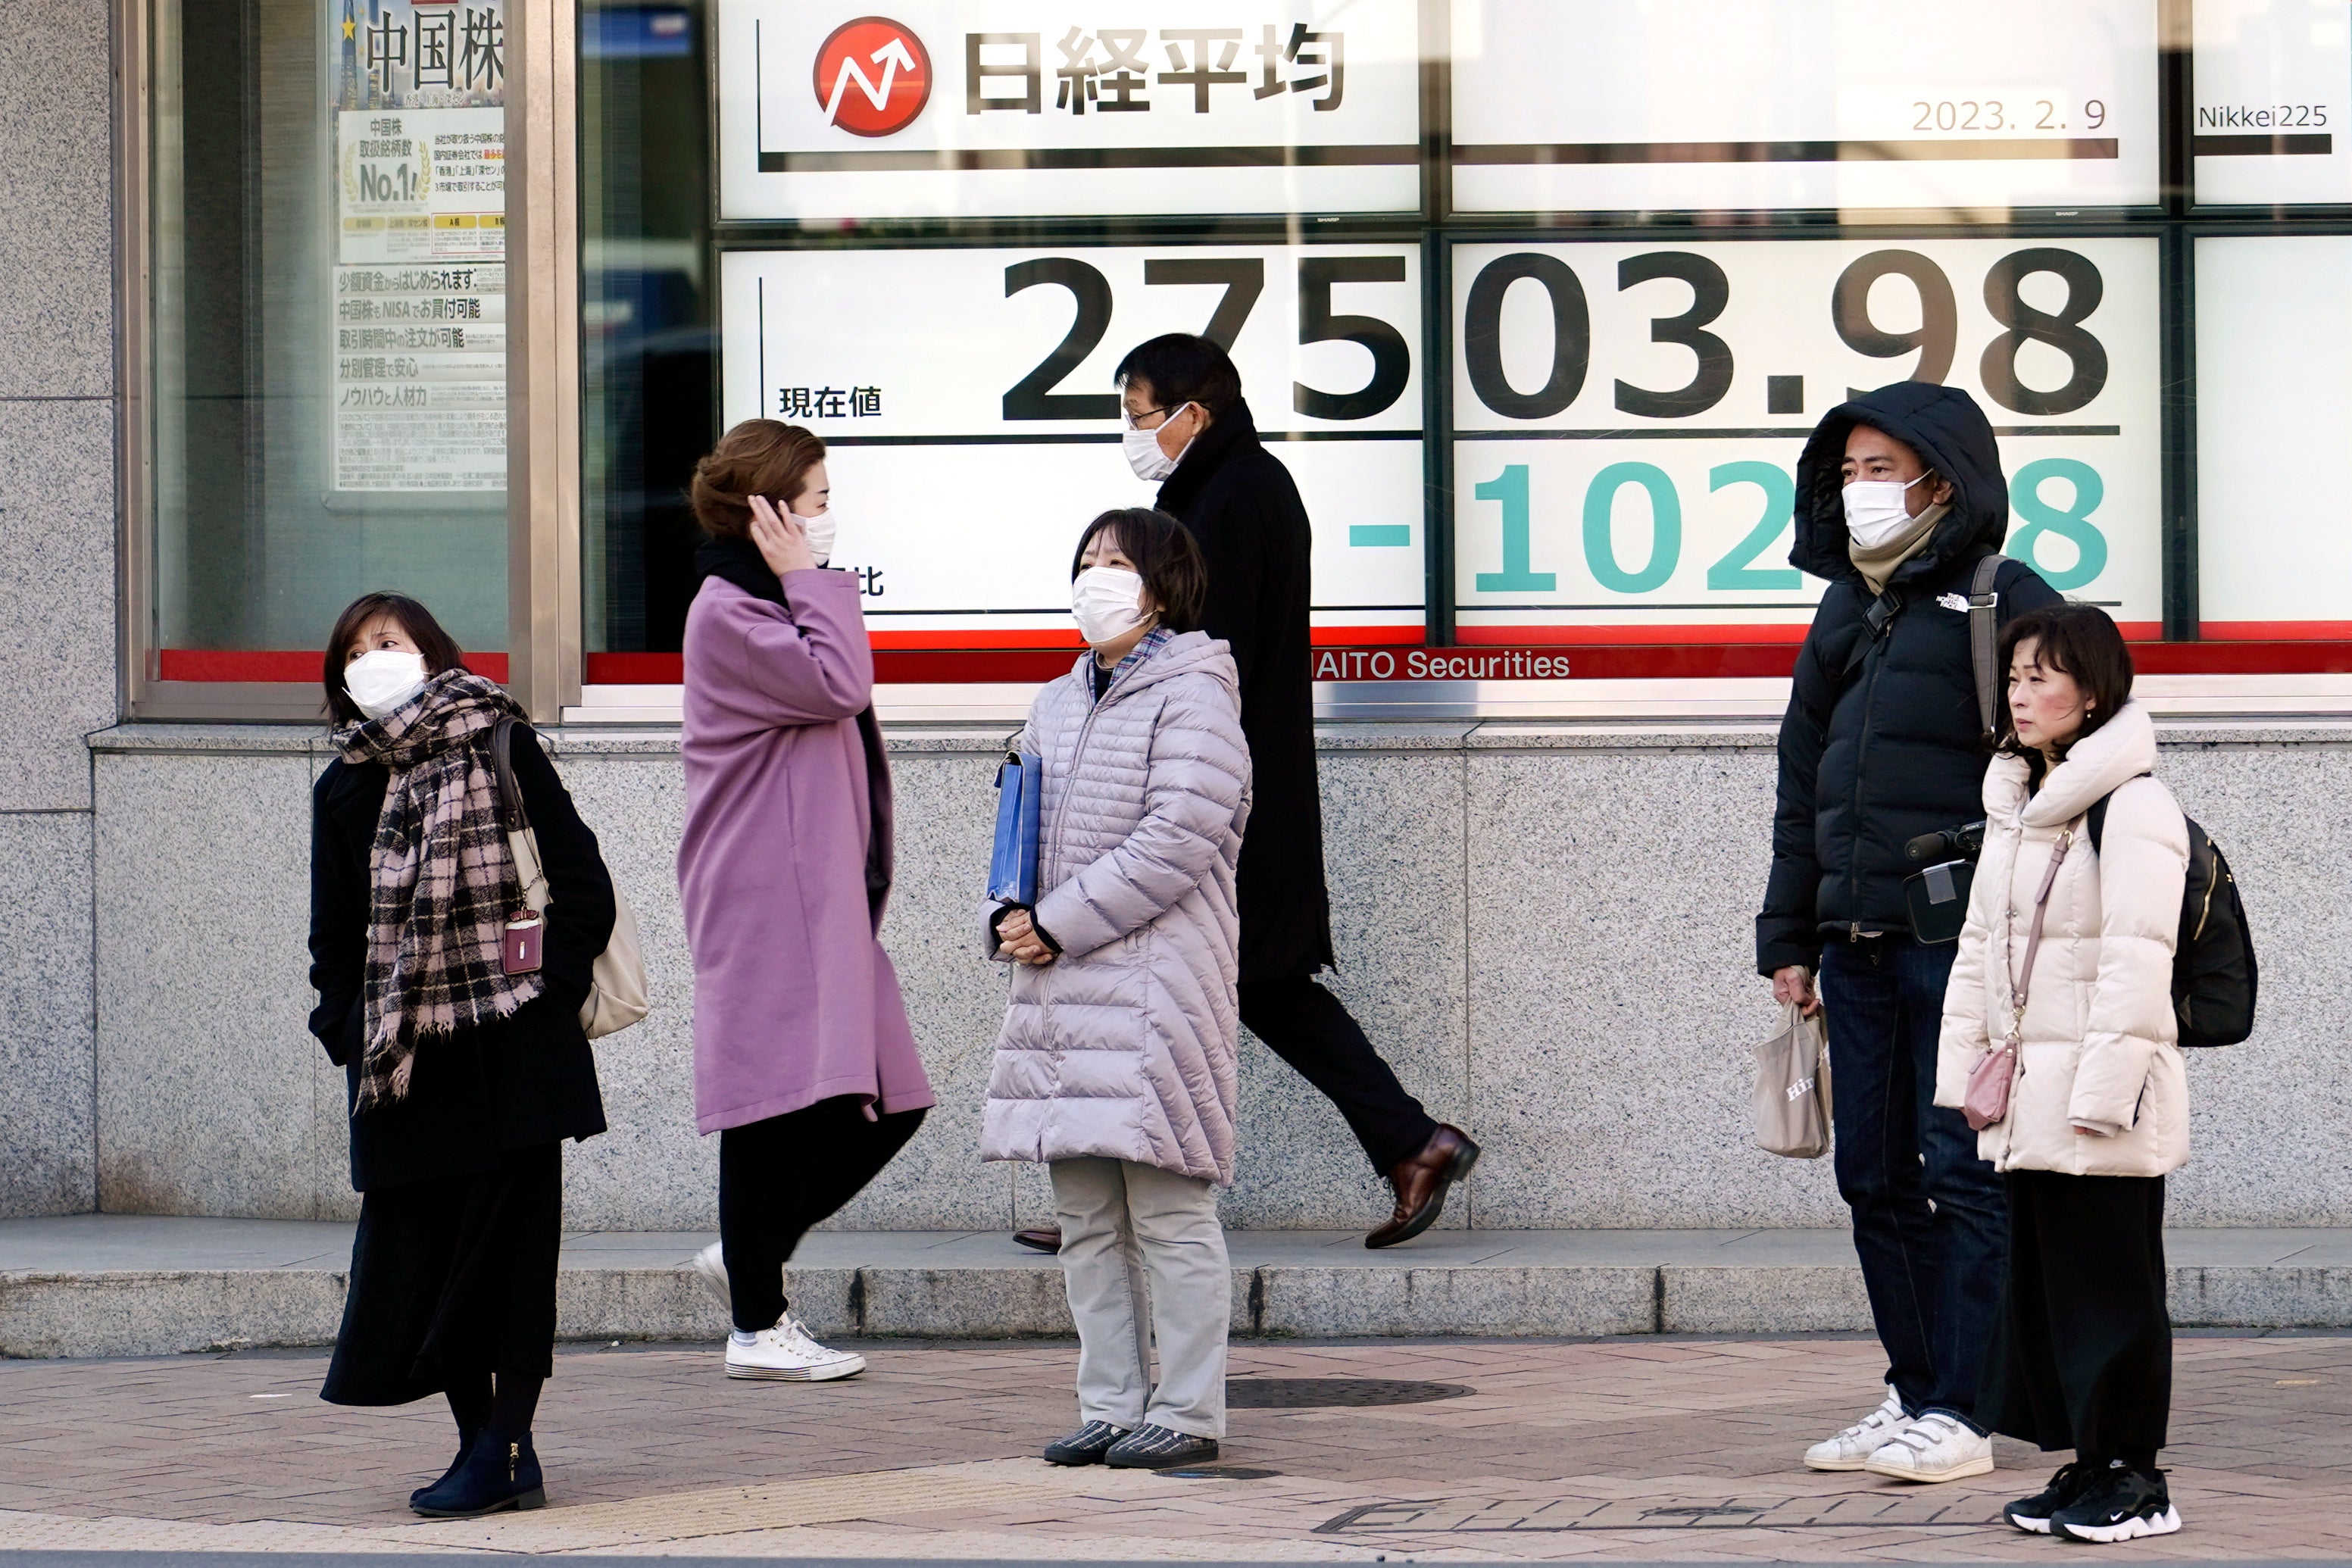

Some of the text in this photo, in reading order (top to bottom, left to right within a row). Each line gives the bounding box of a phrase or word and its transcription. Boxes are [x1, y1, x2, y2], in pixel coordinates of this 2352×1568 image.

[367, 7, 504, 92] 中国株
[965, 22, 1345, 115] 日経平均
[370, 117, 402, 137] 中国株
[1912, 99, 2106, 131] 2023. 2. 9
[2199, 105, 2327, 128] Nikkei225
[359, 139, 412, 158] 取扱銘柄数
[339, 269, 473, 294] 少額資金からはじめられます
[339, 327, 464, 350] 取引時間中の注文が可能
[339, 357, 419, 379] 分別管理で安心
[341, 386, 426, 408] ノウハウと人材力
[779, 386, 882, 418] 現在値
[1311, 650, 1570, 679] AITO Securities
